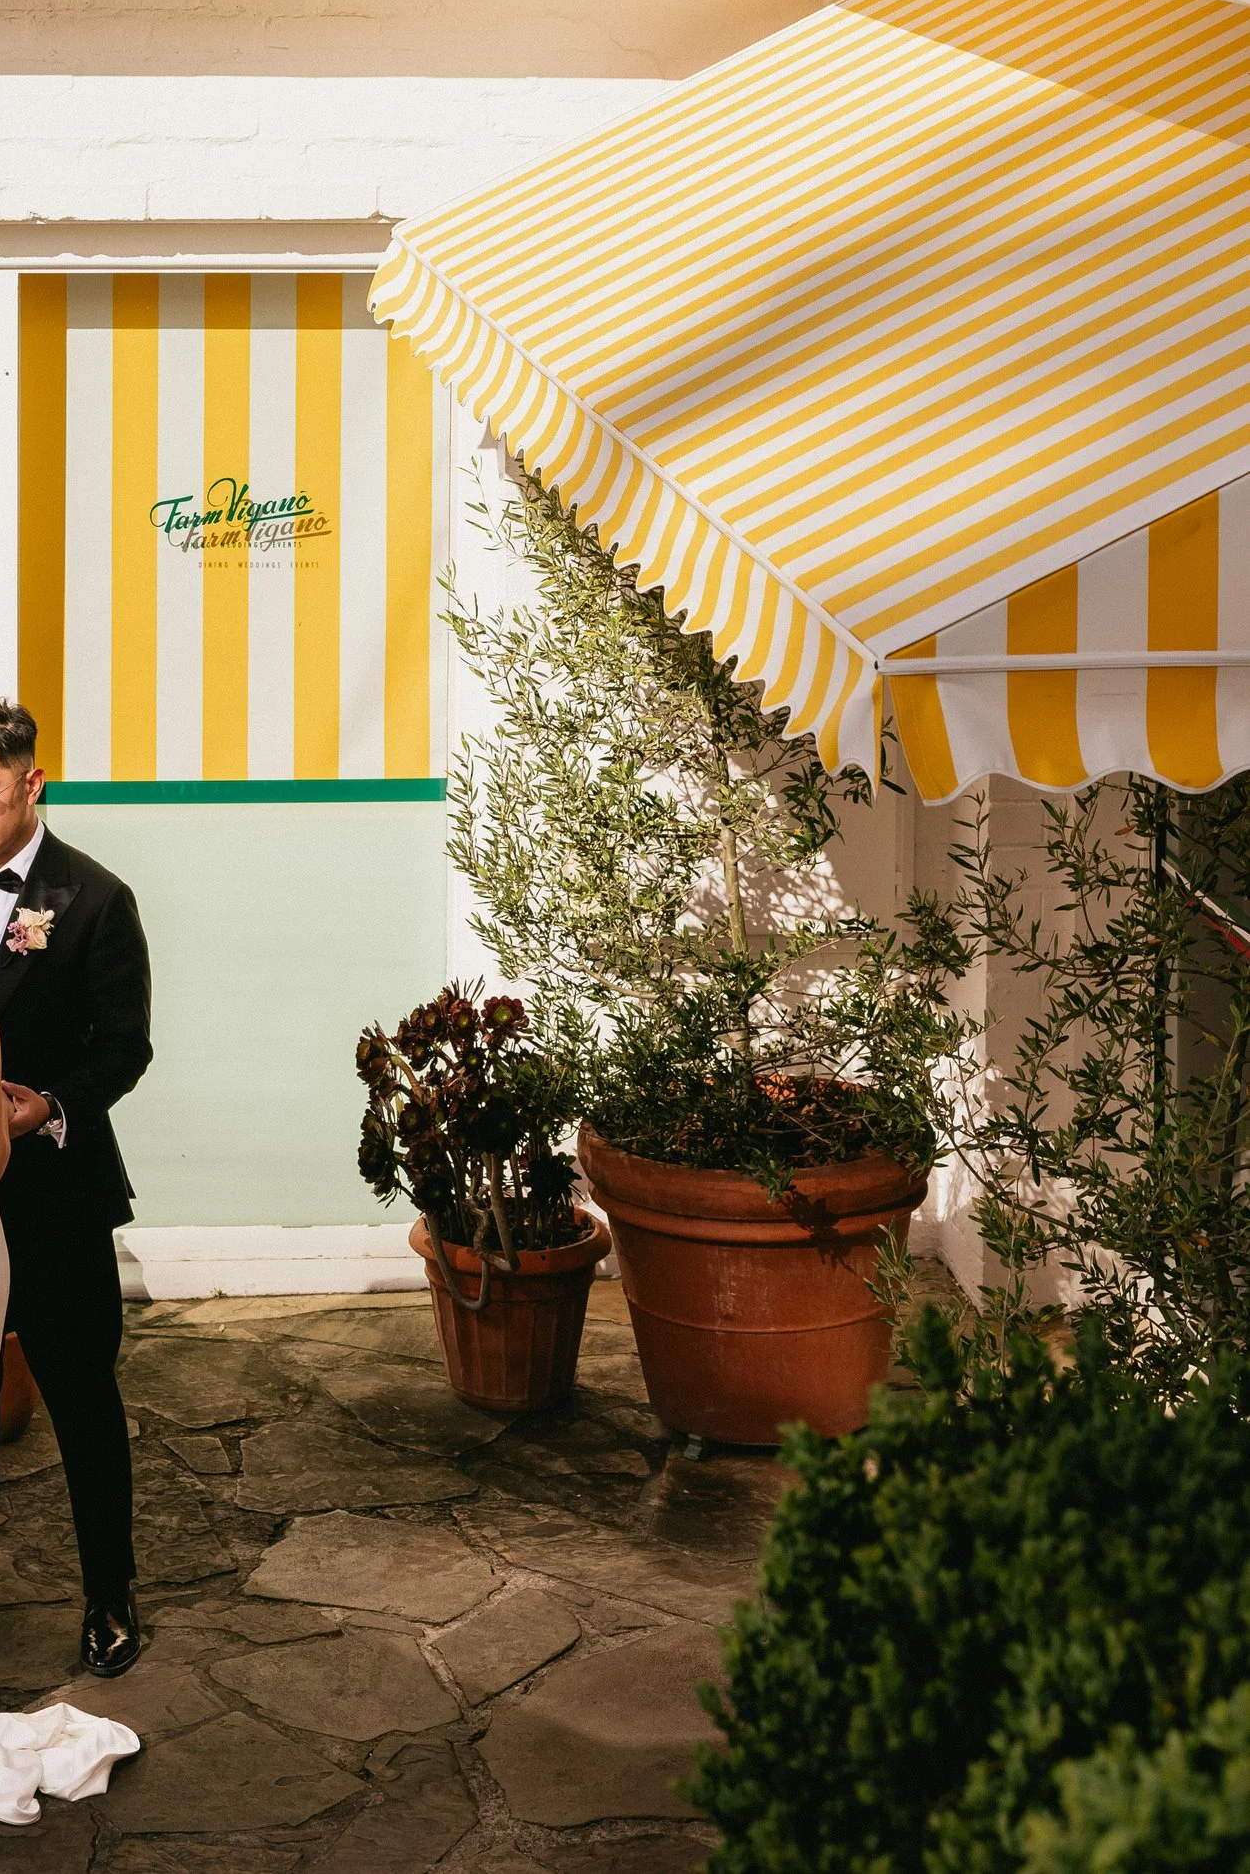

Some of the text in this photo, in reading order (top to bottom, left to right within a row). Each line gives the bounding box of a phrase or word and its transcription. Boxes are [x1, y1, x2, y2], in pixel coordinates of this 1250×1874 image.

[150, 495, 222, 534] Farm
[220, 541, 264, 549] WEDDINGS
[272, 541, 302, 549] EVENTS
